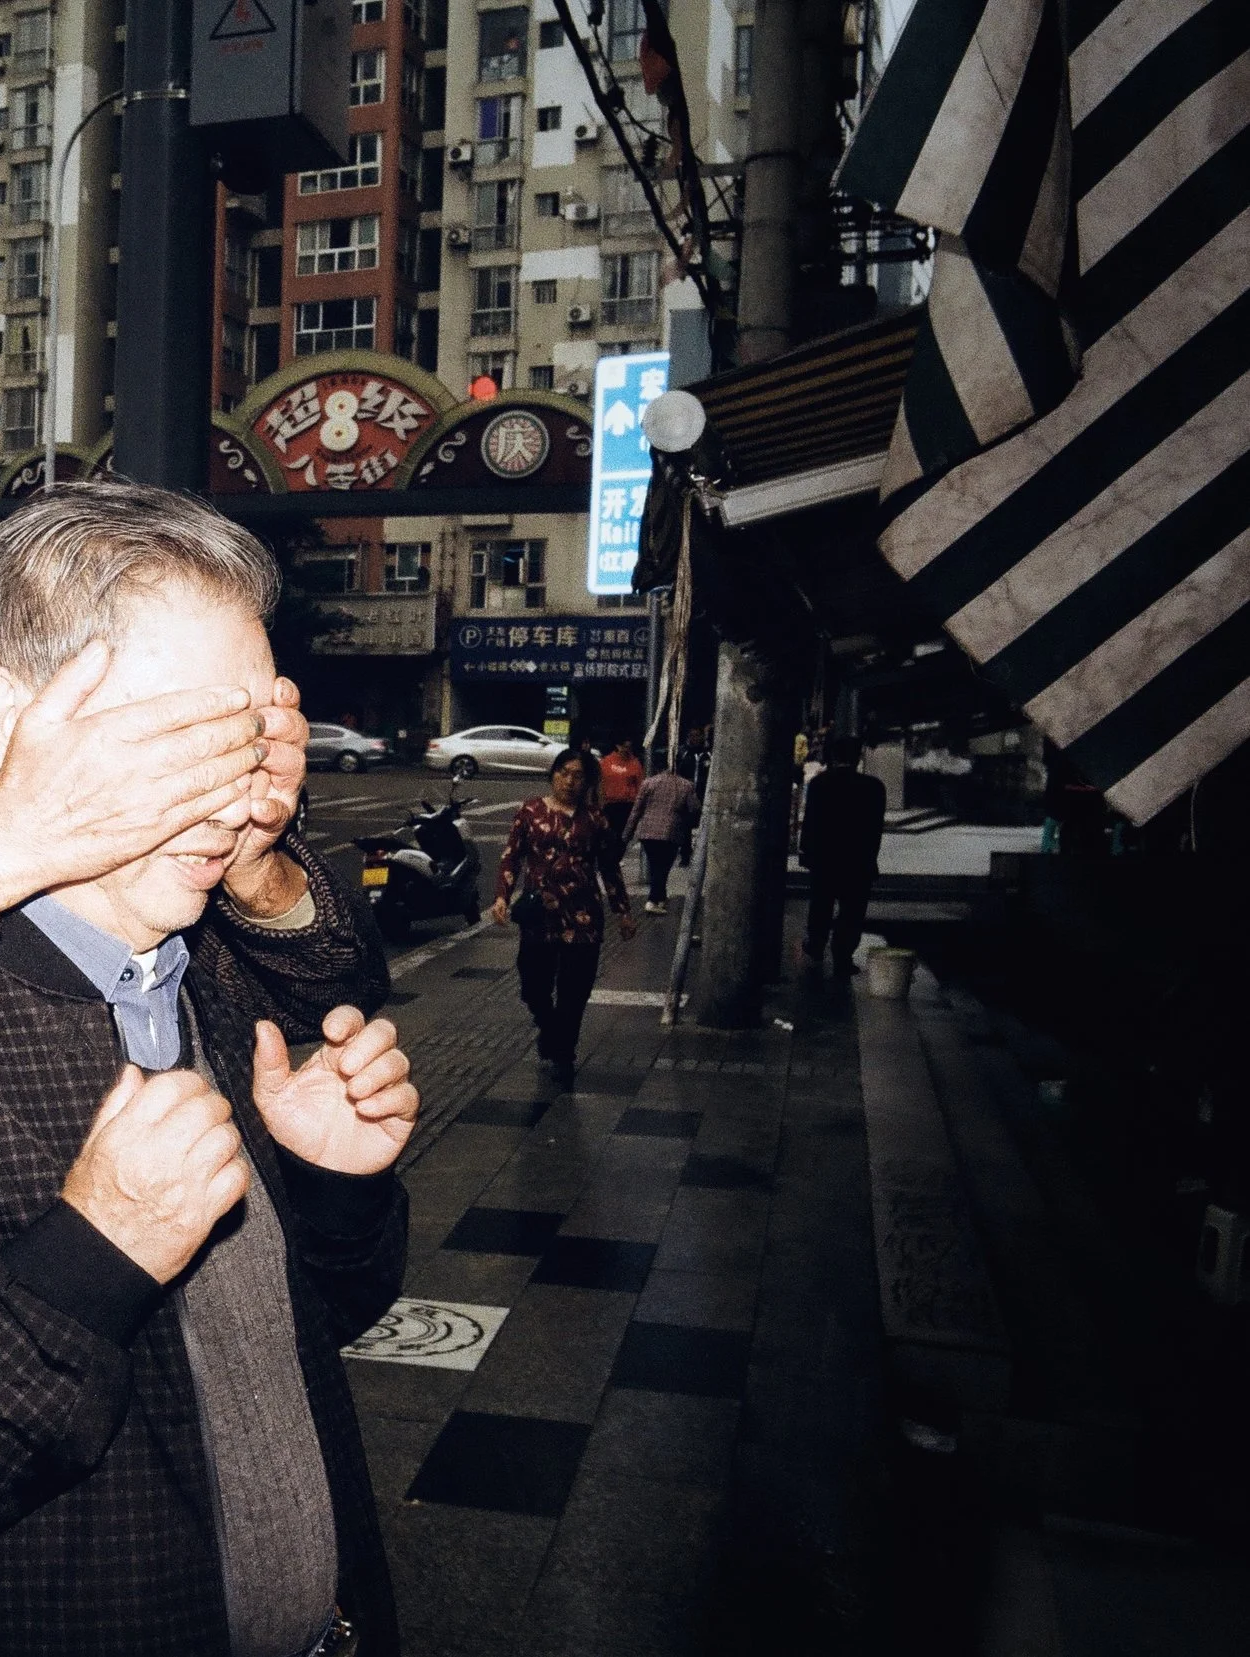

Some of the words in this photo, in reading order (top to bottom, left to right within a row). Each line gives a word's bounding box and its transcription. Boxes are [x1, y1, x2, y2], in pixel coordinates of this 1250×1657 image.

[496, 423, 536, 464] 庆
[508, 625, 579, 648] 停车库
